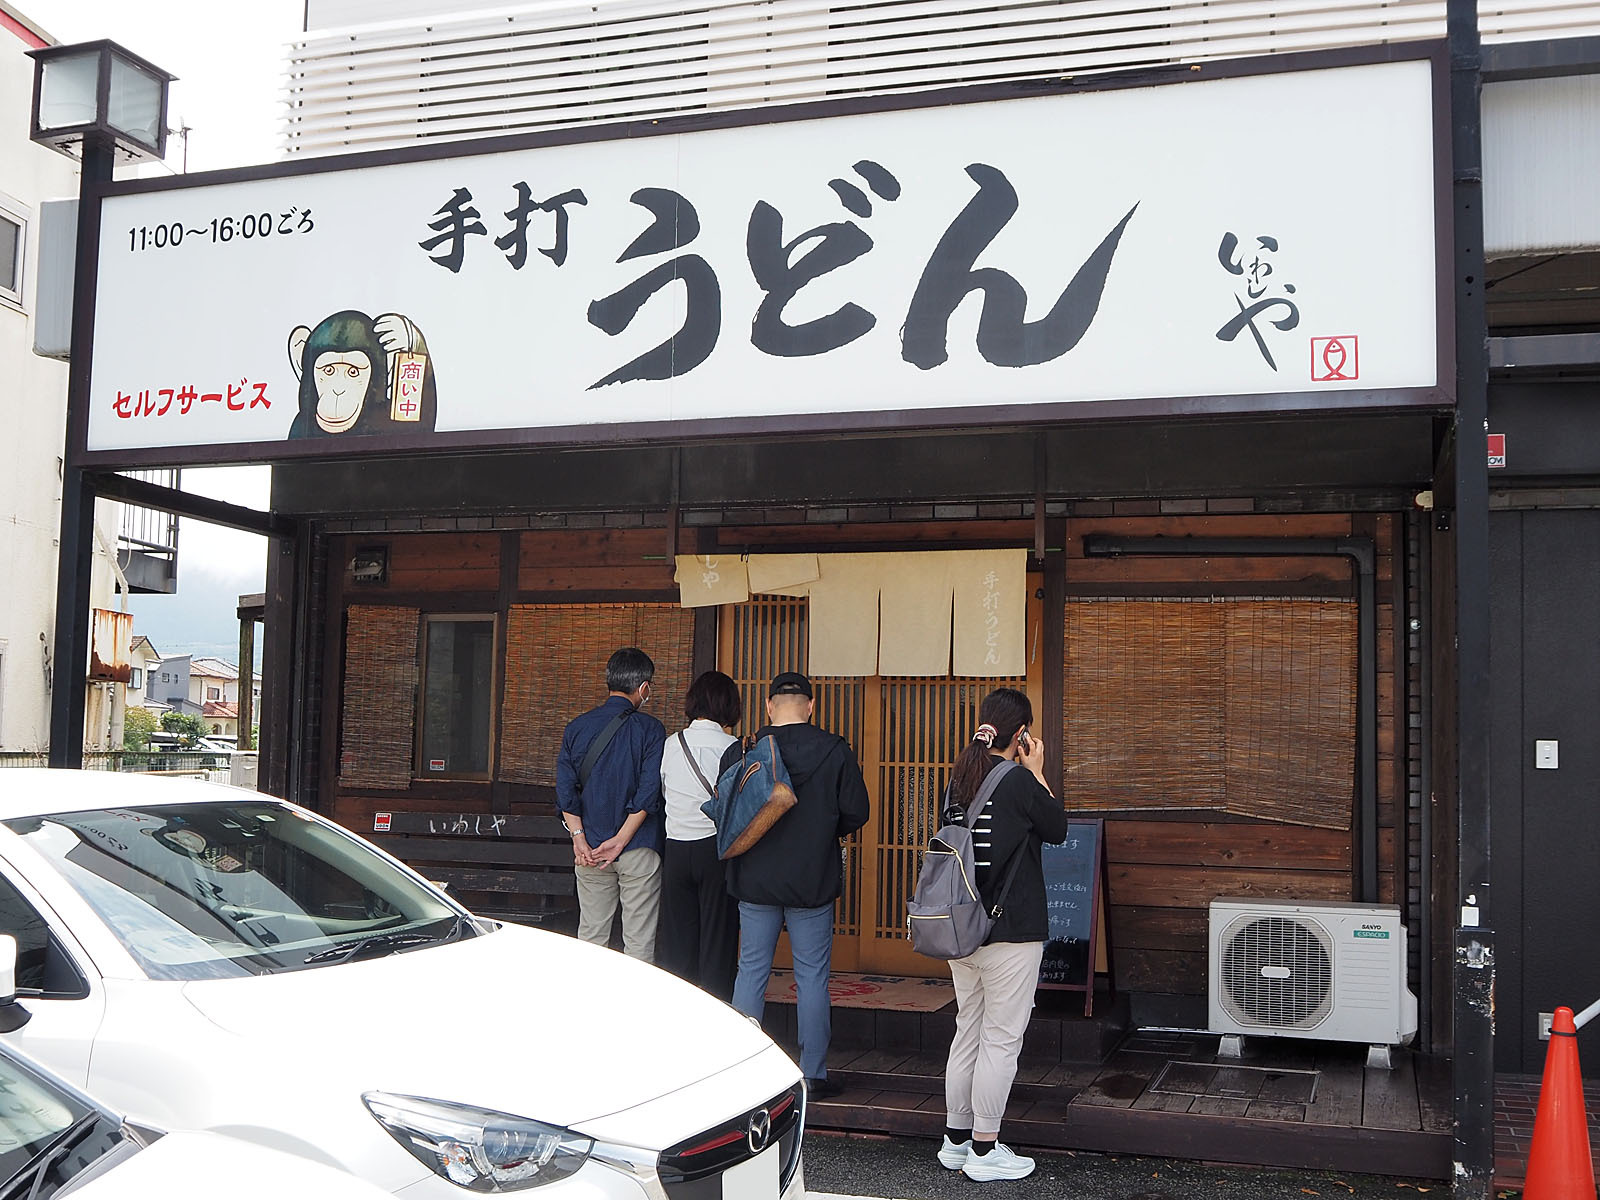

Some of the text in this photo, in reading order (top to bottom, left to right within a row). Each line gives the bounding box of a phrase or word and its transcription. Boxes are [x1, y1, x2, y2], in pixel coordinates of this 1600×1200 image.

[112, 376, 272, 419] セルフサービス
[398, 361, 425, 417] 商い中
[983, 571, 1001, 665] 手打うどん
[430, 814, 506, 837] いわしや
